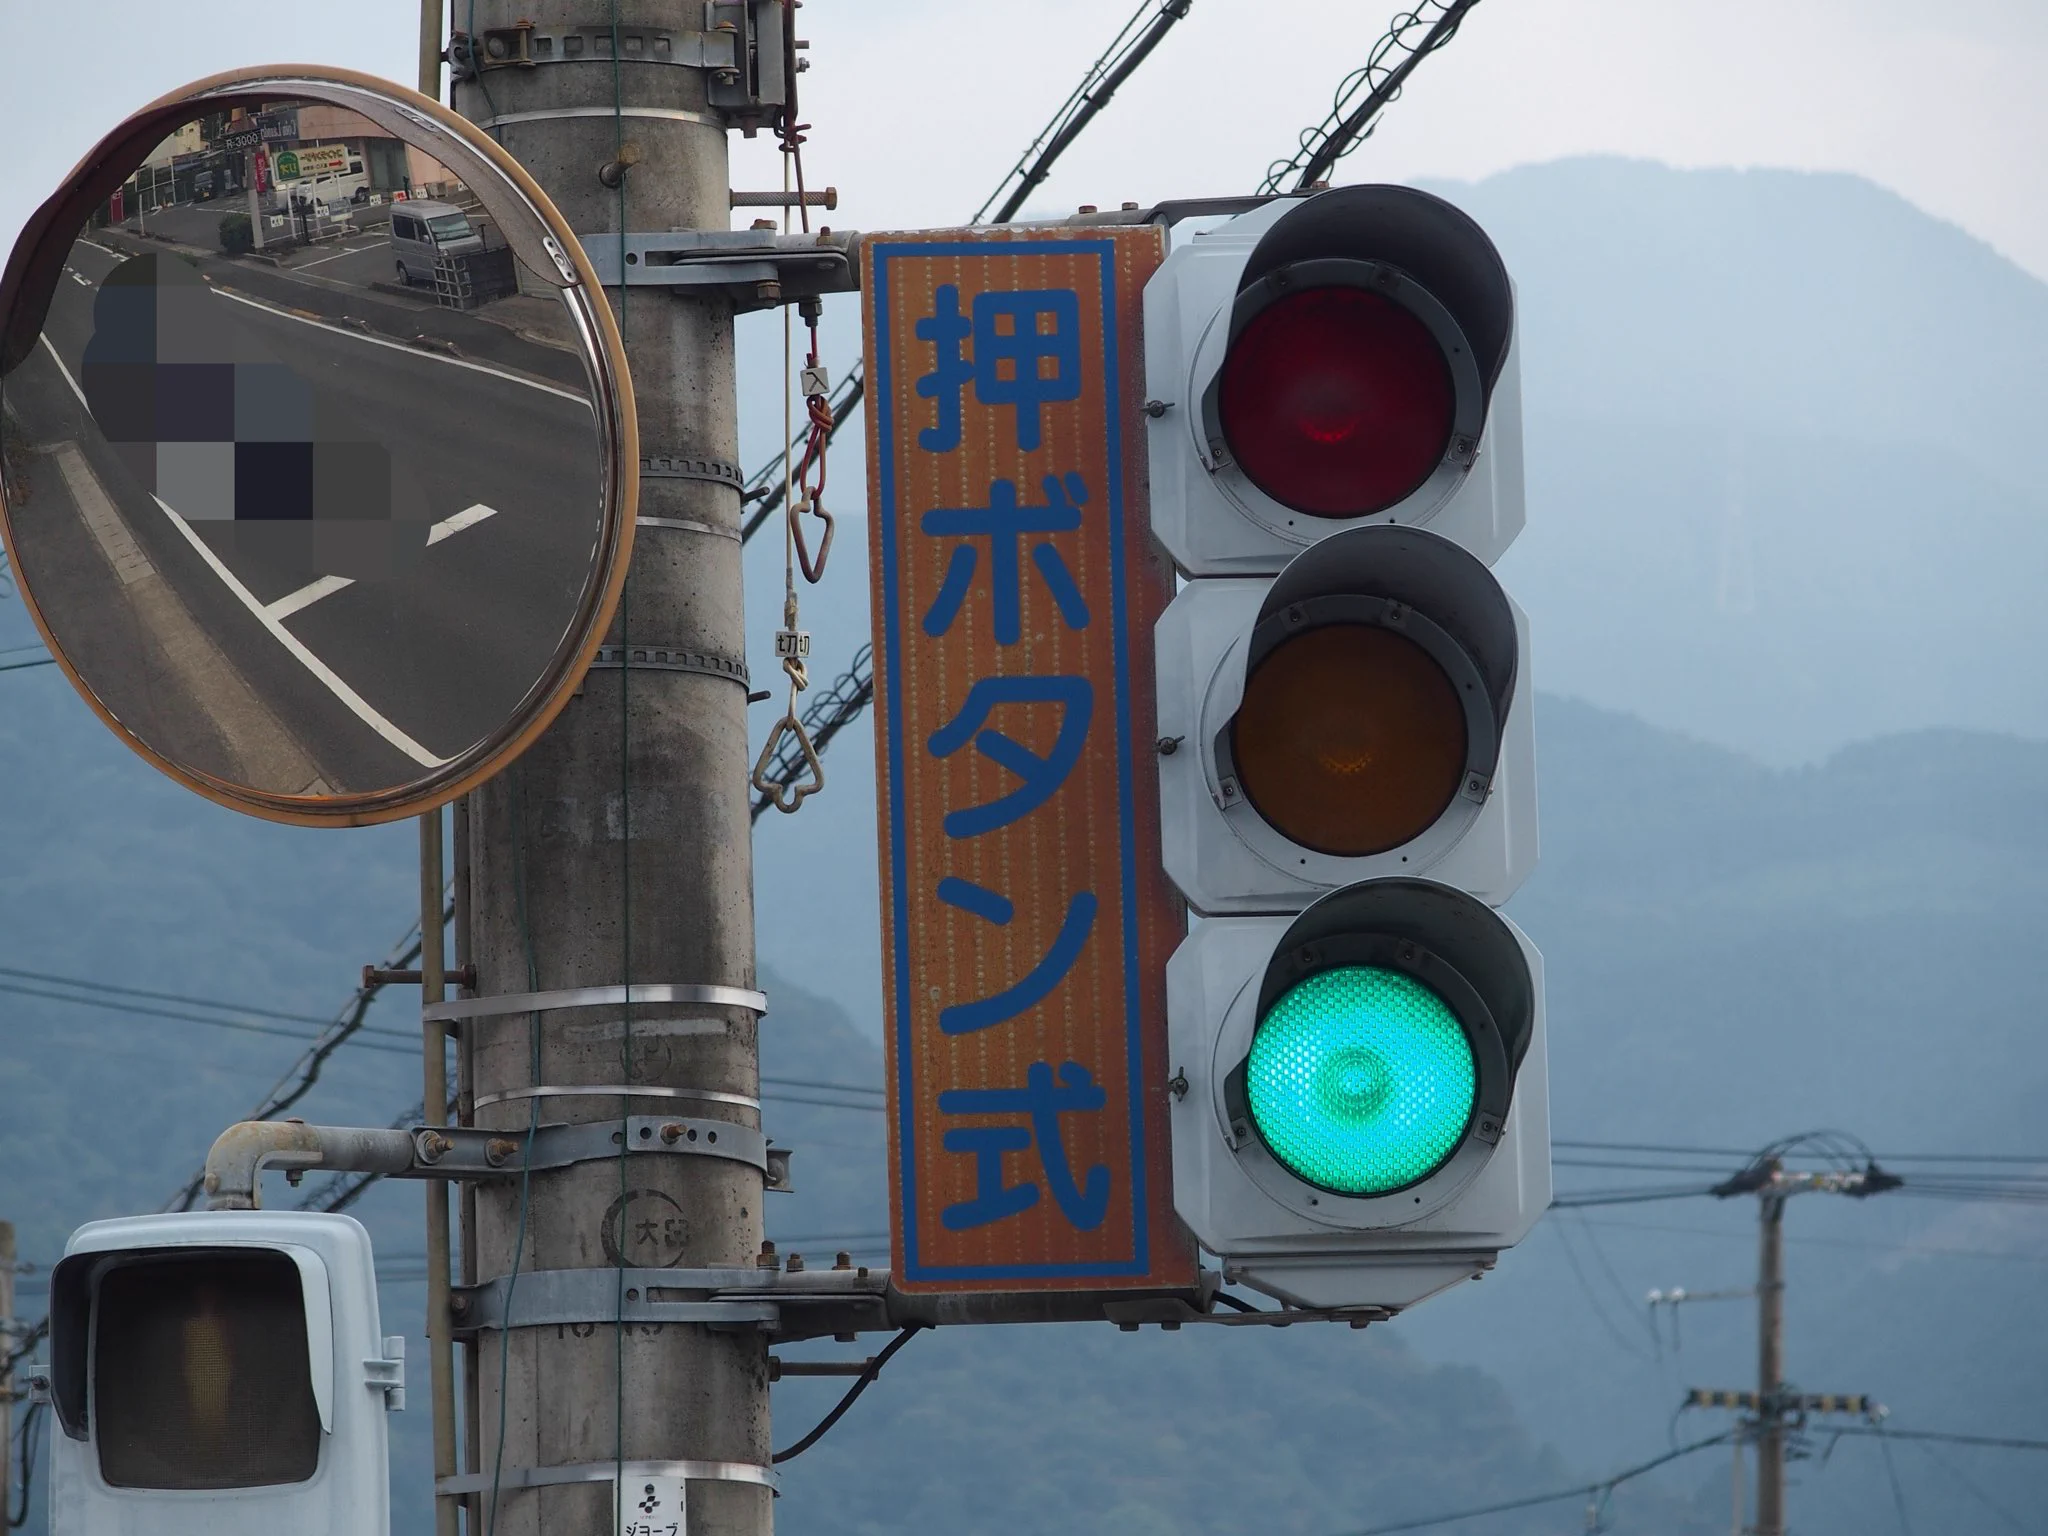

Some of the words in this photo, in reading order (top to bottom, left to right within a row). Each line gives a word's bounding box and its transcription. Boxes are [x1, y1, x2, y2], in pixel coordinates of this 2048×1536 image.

[226, 133, 258, 150] R-3000
[915, 282, 1112, 1231] 押ボタン式
